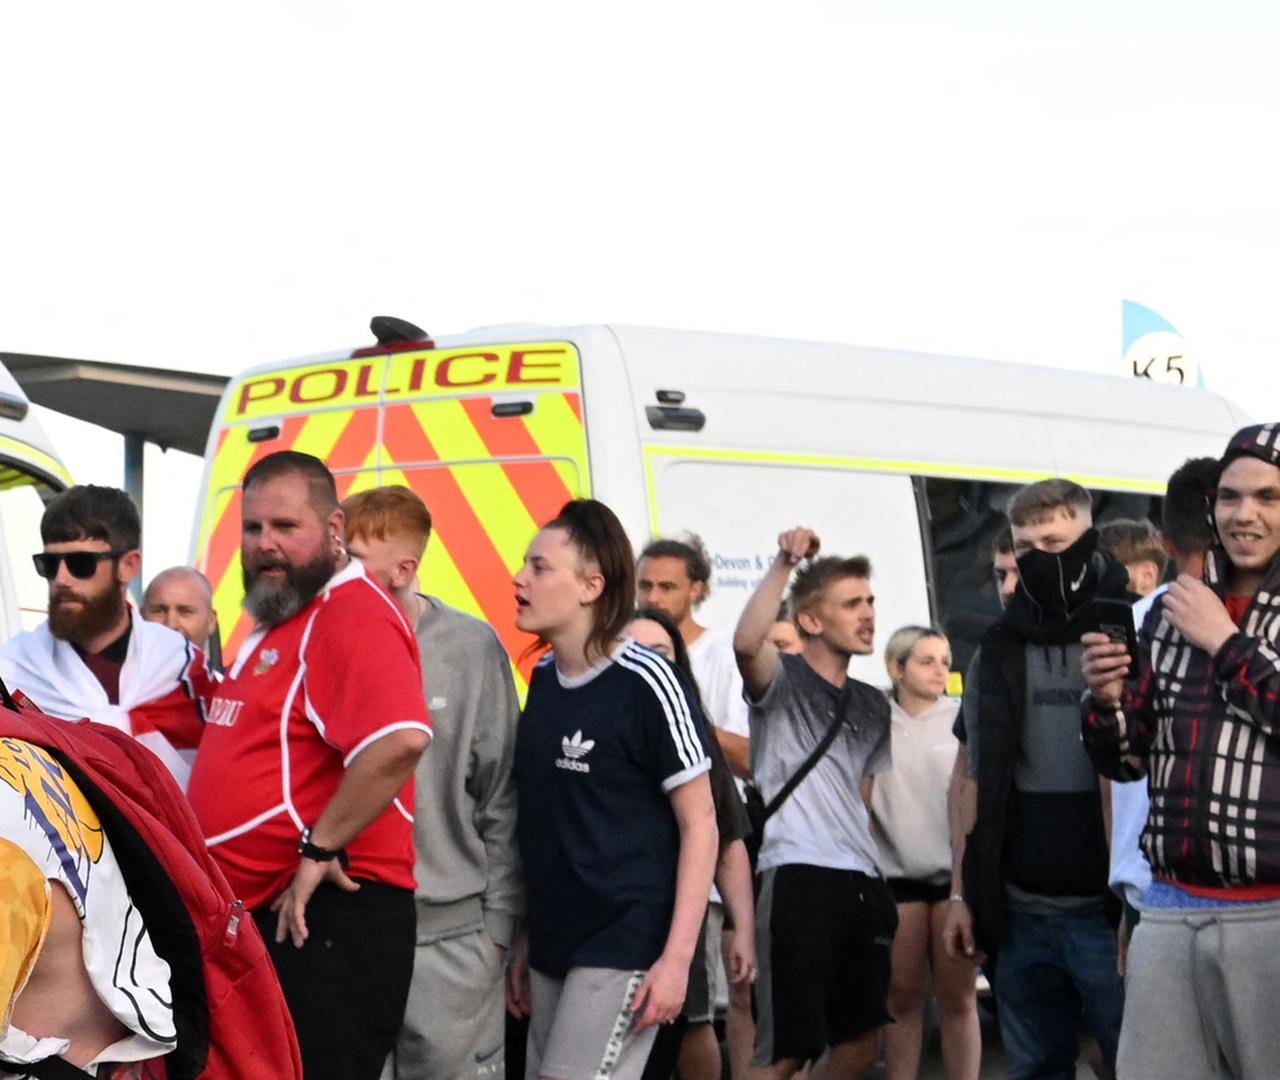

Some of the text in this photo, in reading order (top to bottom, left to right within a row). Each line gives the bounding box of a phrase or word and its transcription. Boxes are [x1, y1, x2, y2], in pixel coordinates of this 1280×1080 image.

[235, 348, 567, 416] POLICE
[1133, 355, 1184, 384] K5
[555, 758, 590, 773] adidas
